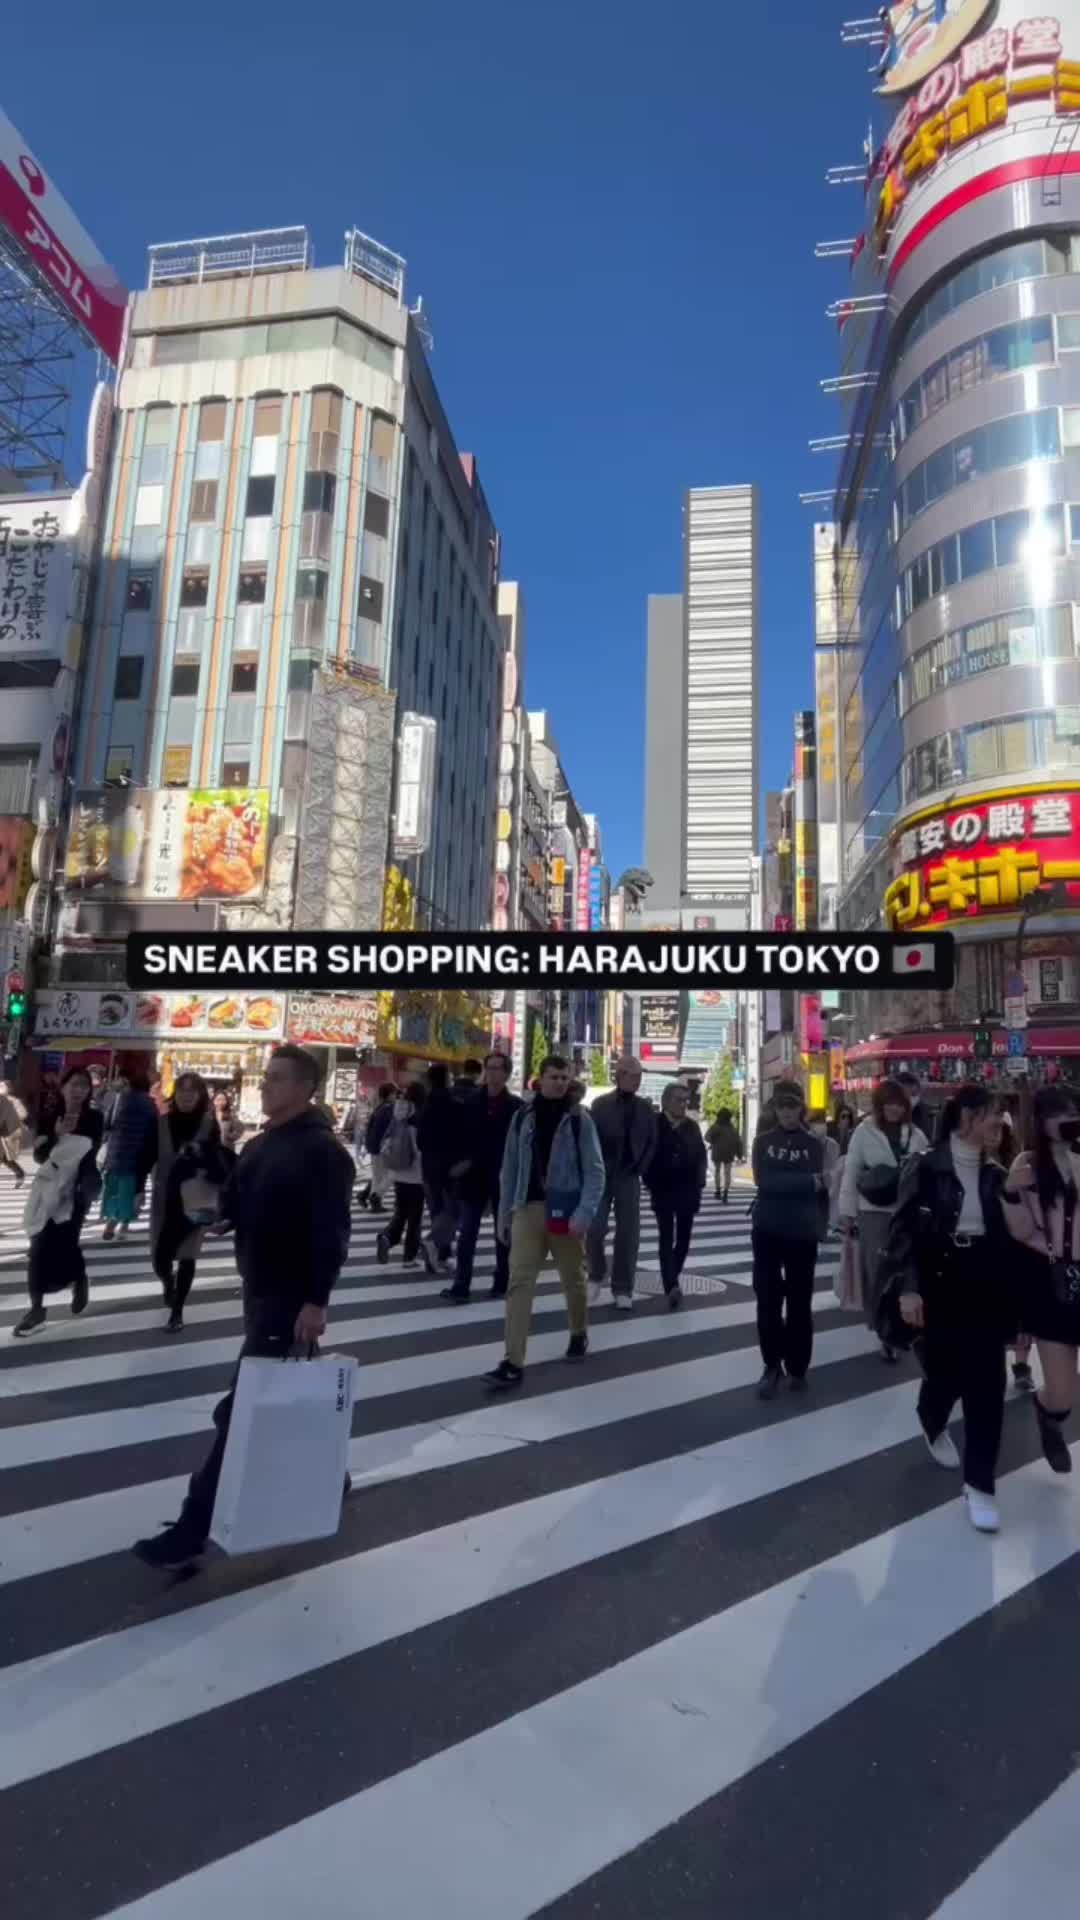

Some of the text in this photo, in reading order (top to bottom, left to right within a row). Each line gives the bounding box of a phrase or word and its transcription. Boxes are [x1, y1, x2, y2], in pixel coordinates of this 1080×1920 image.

[24, 209, 93, 320] アコム
[938, 1042, 964, 1056] Don
